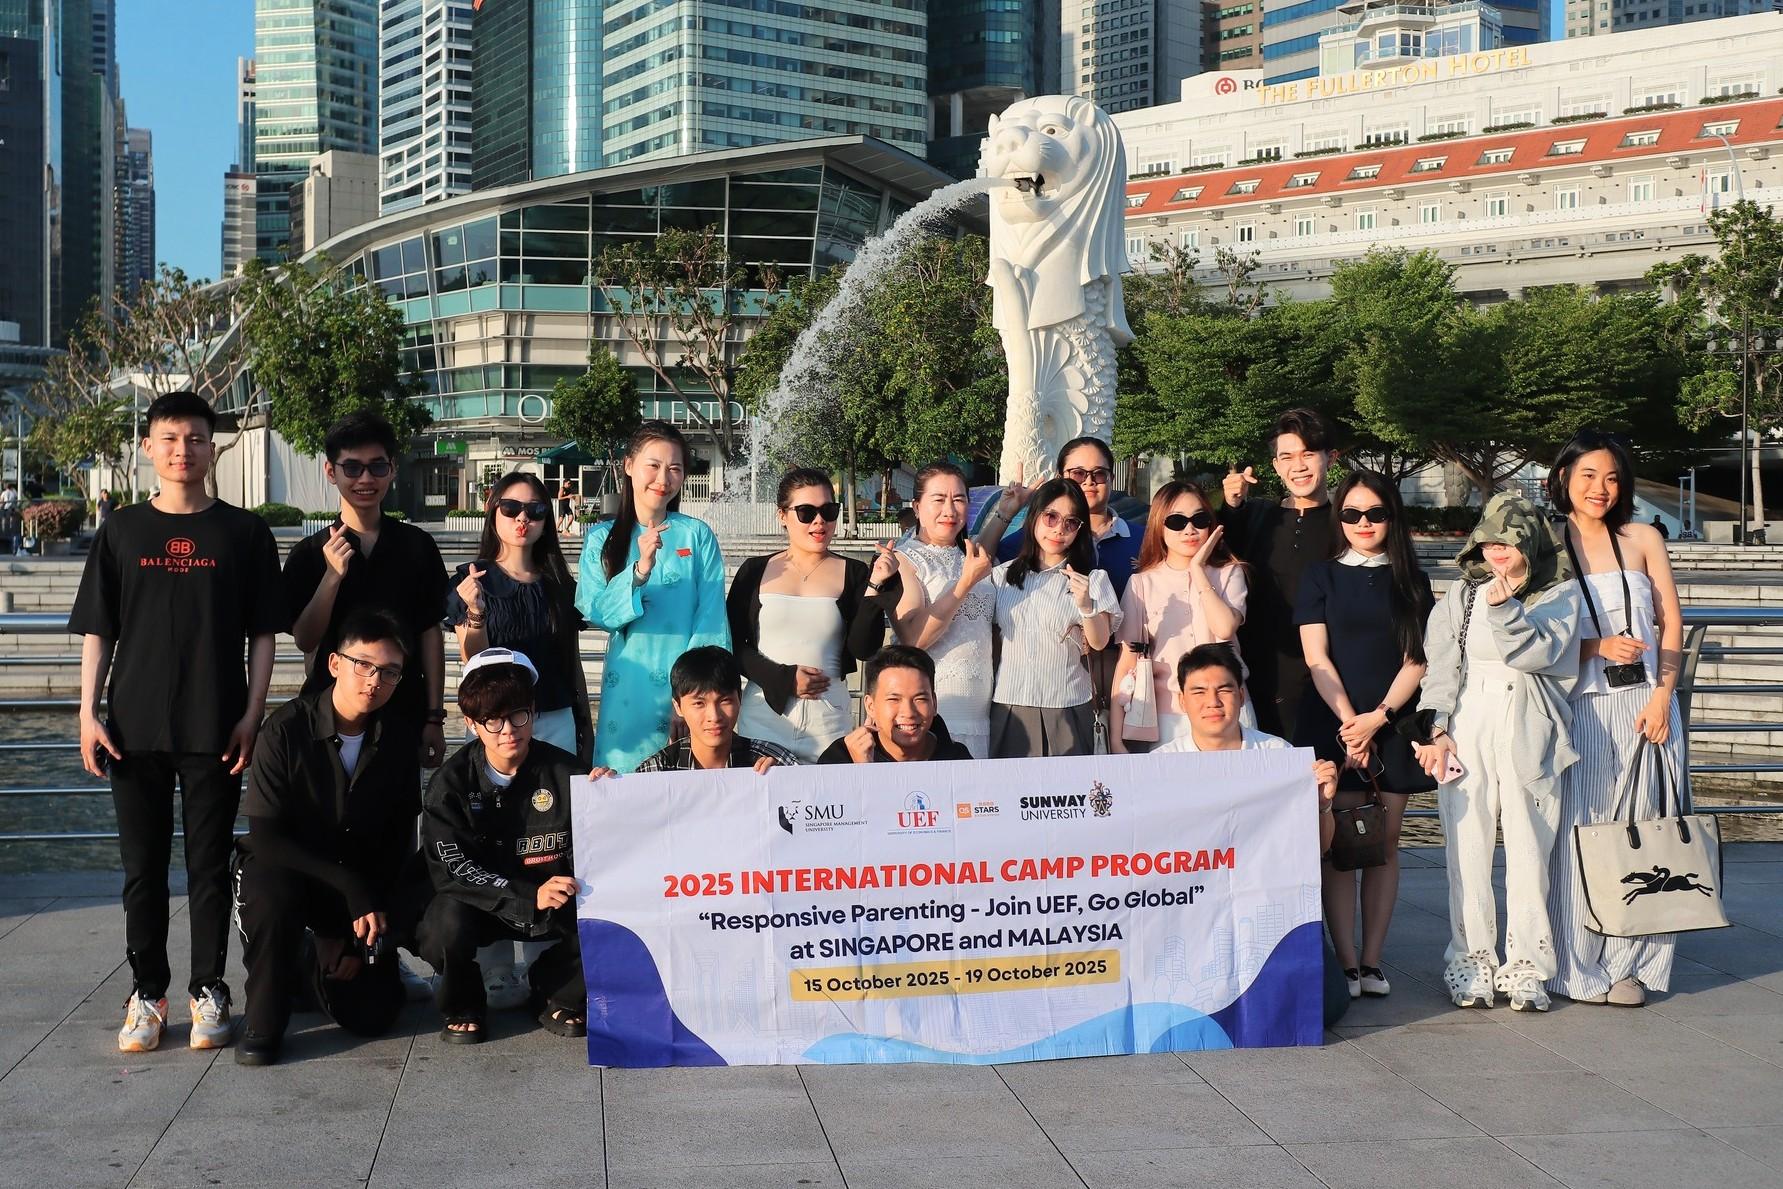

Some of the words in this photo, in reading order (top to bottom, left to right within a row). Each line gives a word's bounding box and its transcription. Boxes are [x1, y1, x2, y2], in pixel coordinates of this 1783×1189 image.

[1257, 83, 1297, 105] THE
[1306, 61, 1438, 98] FULLERTON
[1449, 47, 1533, 75] HOTEL
[518, 447, 539, 456] MOS
[140, 558, 216, 567] BALENCIAGA
[1020, 794, 1087, 809] SUNWAY
[805, 804, 844, 820] SMU
[974, 806, 1000, 814] STARS
[1021, 808, 1087, 821] UNIVERSITY
[897, 811, 939, 828] UEF
[664, 873, 733, 897] 2025
[741, 860, 994, 894] INTERNATIONAL
[1000, 856, 1084, 882] CAMP
[1091, 847, 1235, 877] PROGRAM
[698, 905, 846, 933] “Responsive
[851, 899, 965, 923] Parenting
[985, 896, 1031, 917] Join
[1036, 894, 1083, 916] UEF,
[1088, 893, 1120, 911] Go
[1124, 885, 1205, 908] Global”
[790, 940, 814, 960] at
[819, 932, 954, 958] SINGAPORE
[959, 929, 1001, 950] and
[1008, 923, 1123, 948] MALAYSIA
[804, 978, 822, 992] 15
[827, 975, 901, 992] October
[906, 971, 949, 987] 2025
[965, 969, 983, 984] 19
[987, 965, 1060, 982] October
[1065, 959, 1107, 976] 2025
